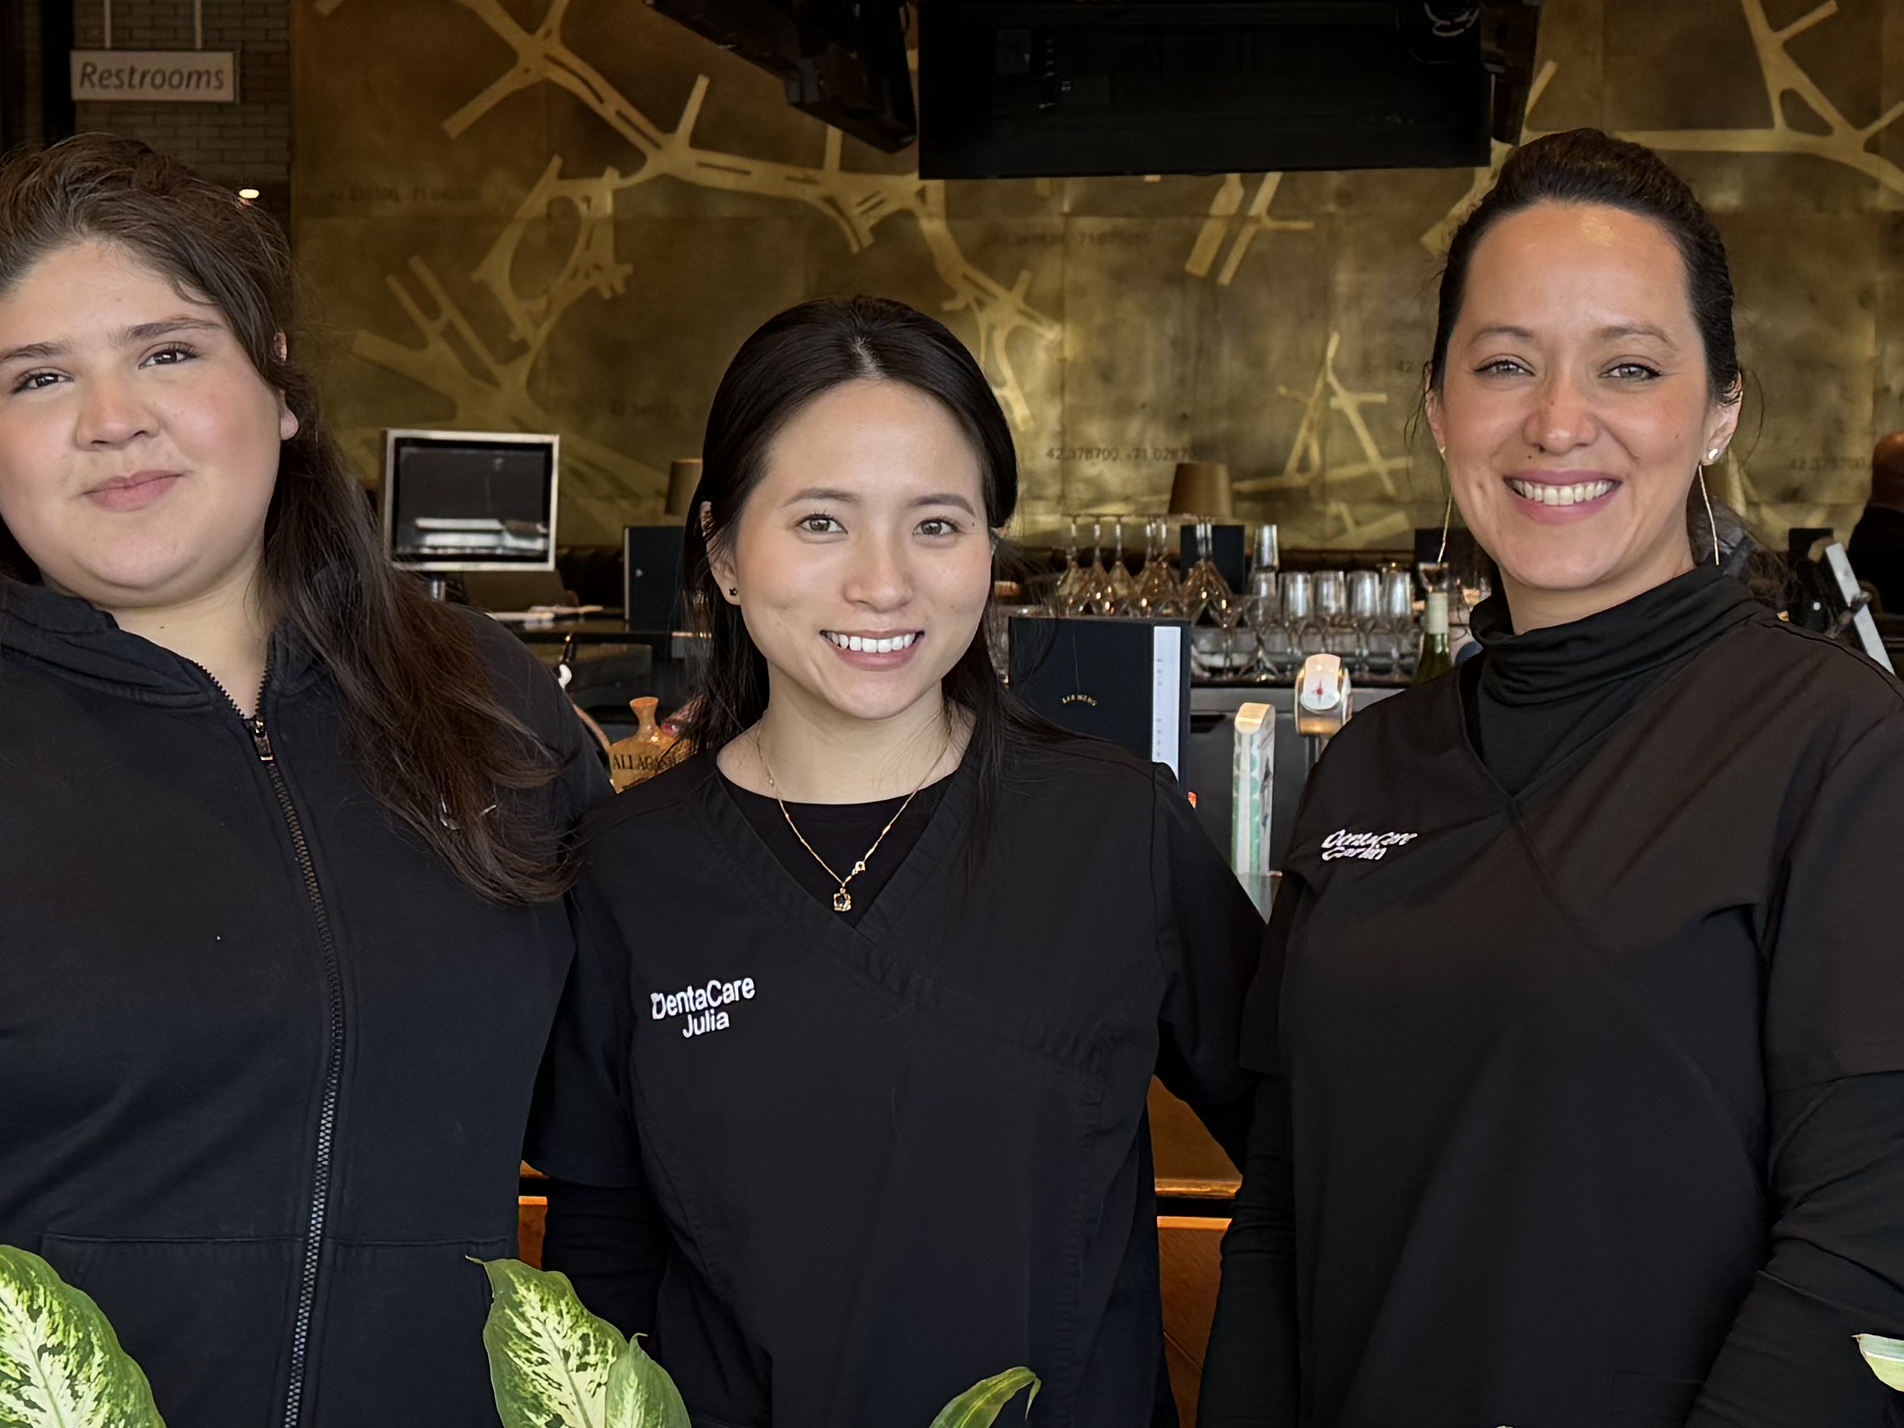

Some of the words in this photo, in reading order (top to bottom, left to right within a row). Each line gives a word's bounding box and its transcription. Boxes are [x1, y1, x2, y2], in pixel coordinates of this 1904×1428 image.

[79, 61, 224, 90] Restrooms
[650, 977, 756, 1020] DentaCare
[682, 1009, 730, 1039] Julia
